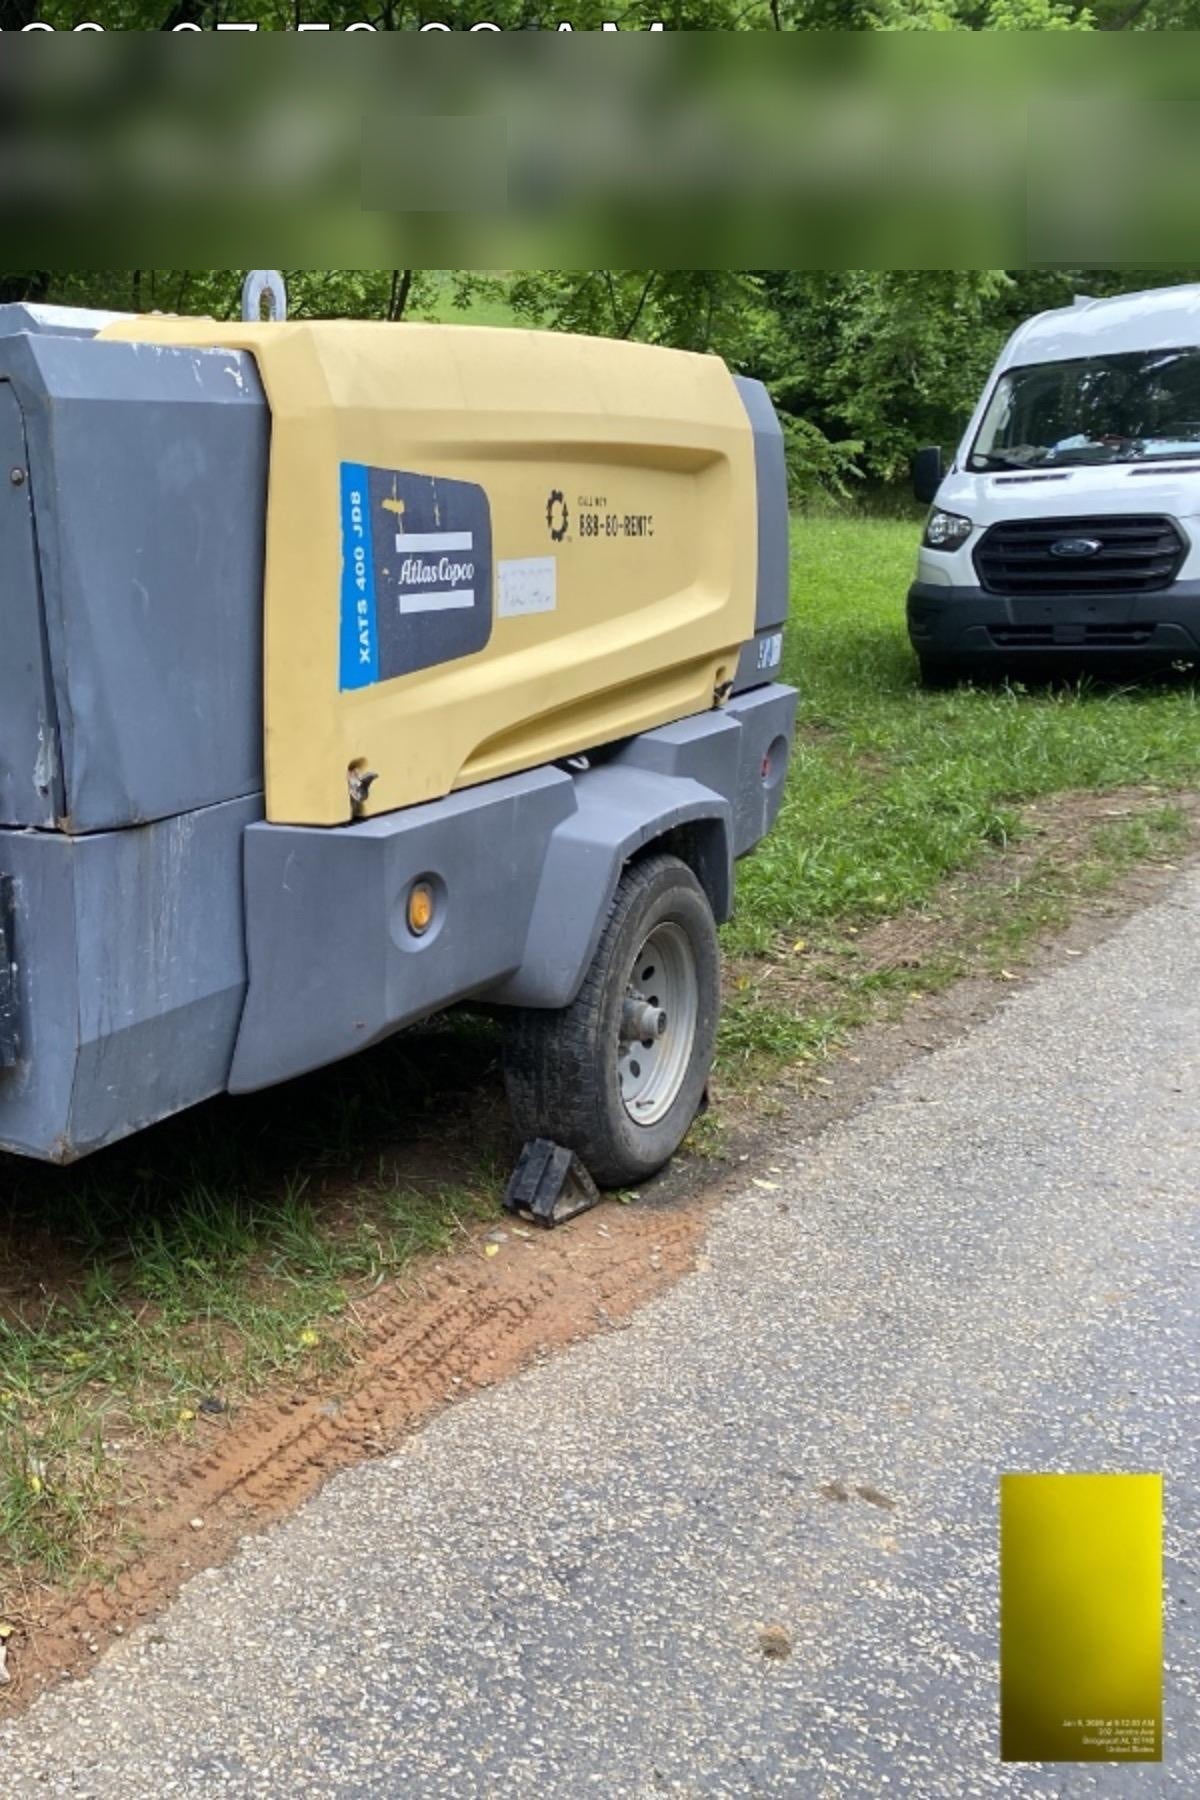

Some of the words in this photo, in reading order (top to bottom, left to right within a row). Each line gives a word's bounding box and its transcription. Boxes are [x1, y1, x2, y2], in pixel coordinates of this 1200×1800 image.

[351, 491, 363, 538] JDB
[353, 546, 366, 591] 400
[398, 559, 437, 585] Atlas
[438, 556, 475, 587] Copco
[357, 599, 371, 664] XATS
